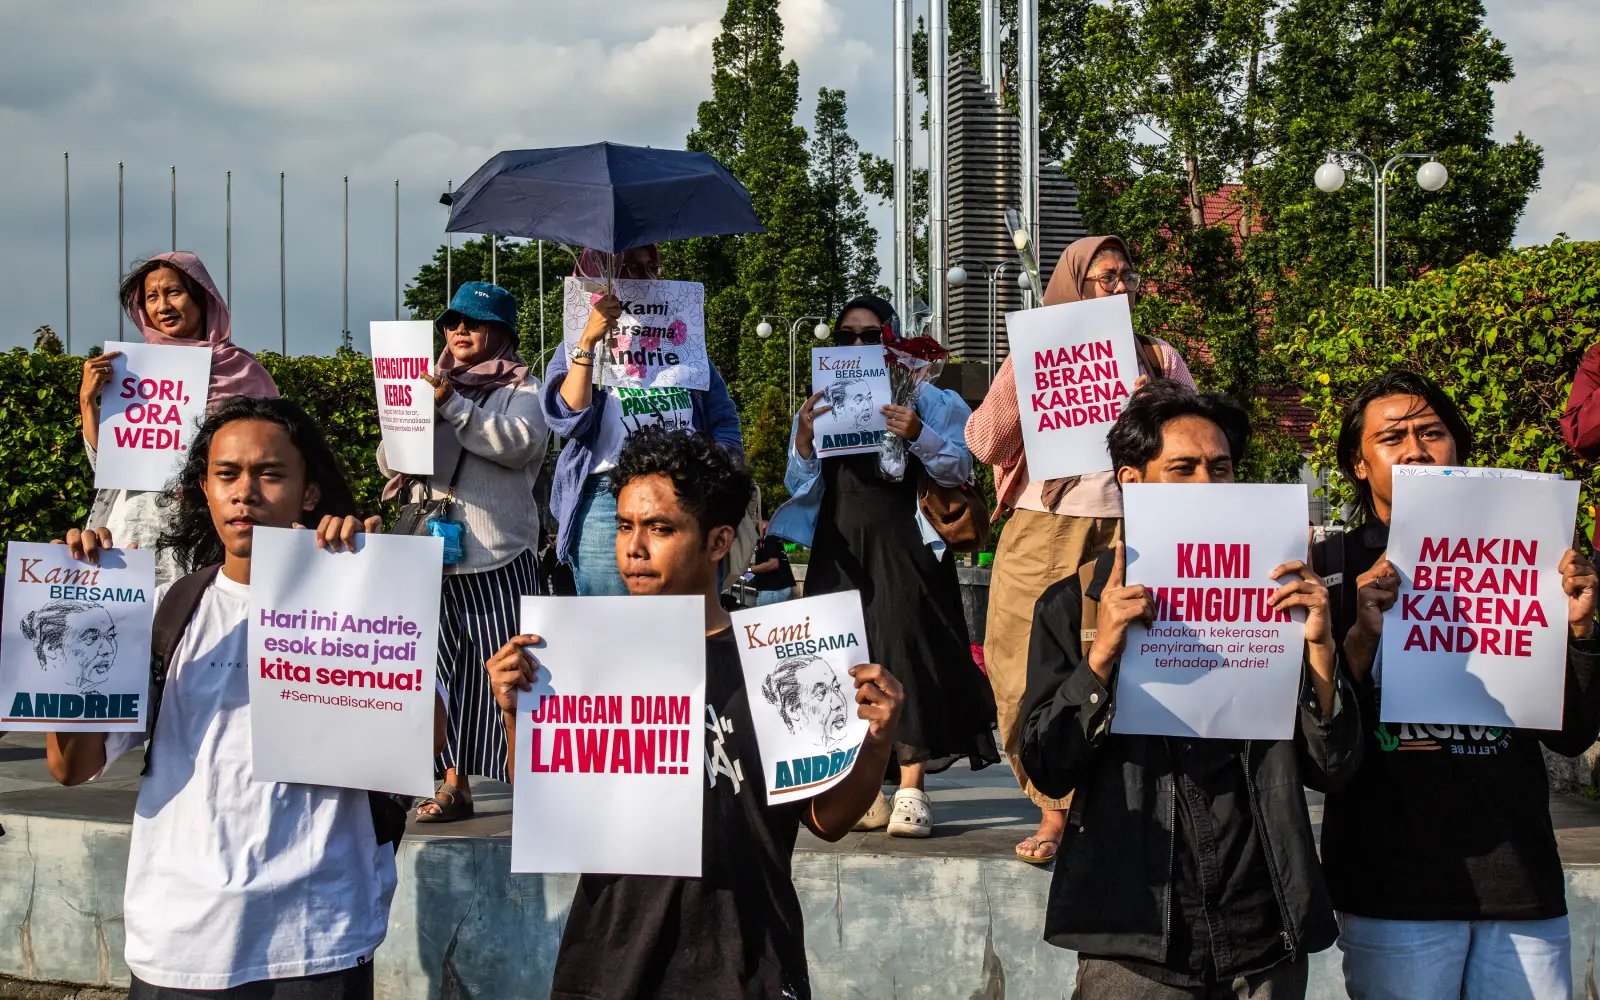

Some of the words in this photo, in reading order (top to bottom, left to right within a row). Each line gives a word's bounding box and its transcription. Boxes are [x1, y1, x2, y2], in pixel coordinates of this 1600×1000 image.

[619, 300, 669, 316] Kami
[611, 325, 676, 339] ersama
[374, 357, 430, 380] MENGUTUK
[609, 346, 681, 367] Andrie
[818, 356, 861, 371] Kami
[1034, 339, 1113, 370] MAKIN
[835, 368, 886, 379] BERSAMA
[1034, 360, 1119, 391] BERANI
[120, 377, 190, 405] SORI,
[384, 384, 412, 407] KERAS
[1031, 380, 1130, 412] KARENA
[125, 402, 182, 425] ORA
[114, 426, 187, 450] WEDI.
[1177, 543, 1251, 579] KAMI
[1419, 537, 1538, 566] MAKIN
[18, 558, 102, 586] Kami
[1412, 565, 1538, 596] BERANI
[50, 585, 146, 603] BERSAMA
[260, 608, 308, 630] Hari
[310, 609, 338, 632] ini
[340, 614, 422, 639] Andrie,
[1401, 593, 1549, 628] KARENA
[744, 616, 811, 650] Kami
[774, 632, 859, 660] BERSAMA
[1146, 626, 1206, 638] tindakan
[1210, 626, 1279, 638] kekerasan
[1403, 624, 1533, 657] ANDRIE
[264, 636, 318, 656] esok
[321, 637, 369, 659] bisa
[371, 639, 416, 666] jadi
[1140, 641, 1224, 655] penyiraman
[1227, 642, 1244, 653] air
[1248, 642, 1285, 654] keras
[260, 657, 311, 683] kita
[315, 667, 423, 692] semua!
[1155, 657, 1219, 671] terhadap
[1221, 657, 1269, 669] Andrie!
[9, 692, 139, 718] ANDRIE
[280, 688, 403, 712] #SemuaBisaKena
[531, 695, 623, 724] JANGAN
[631, 695, 691, 725] DIAM
[531, 728, 690, 775] LAWAN!!!
